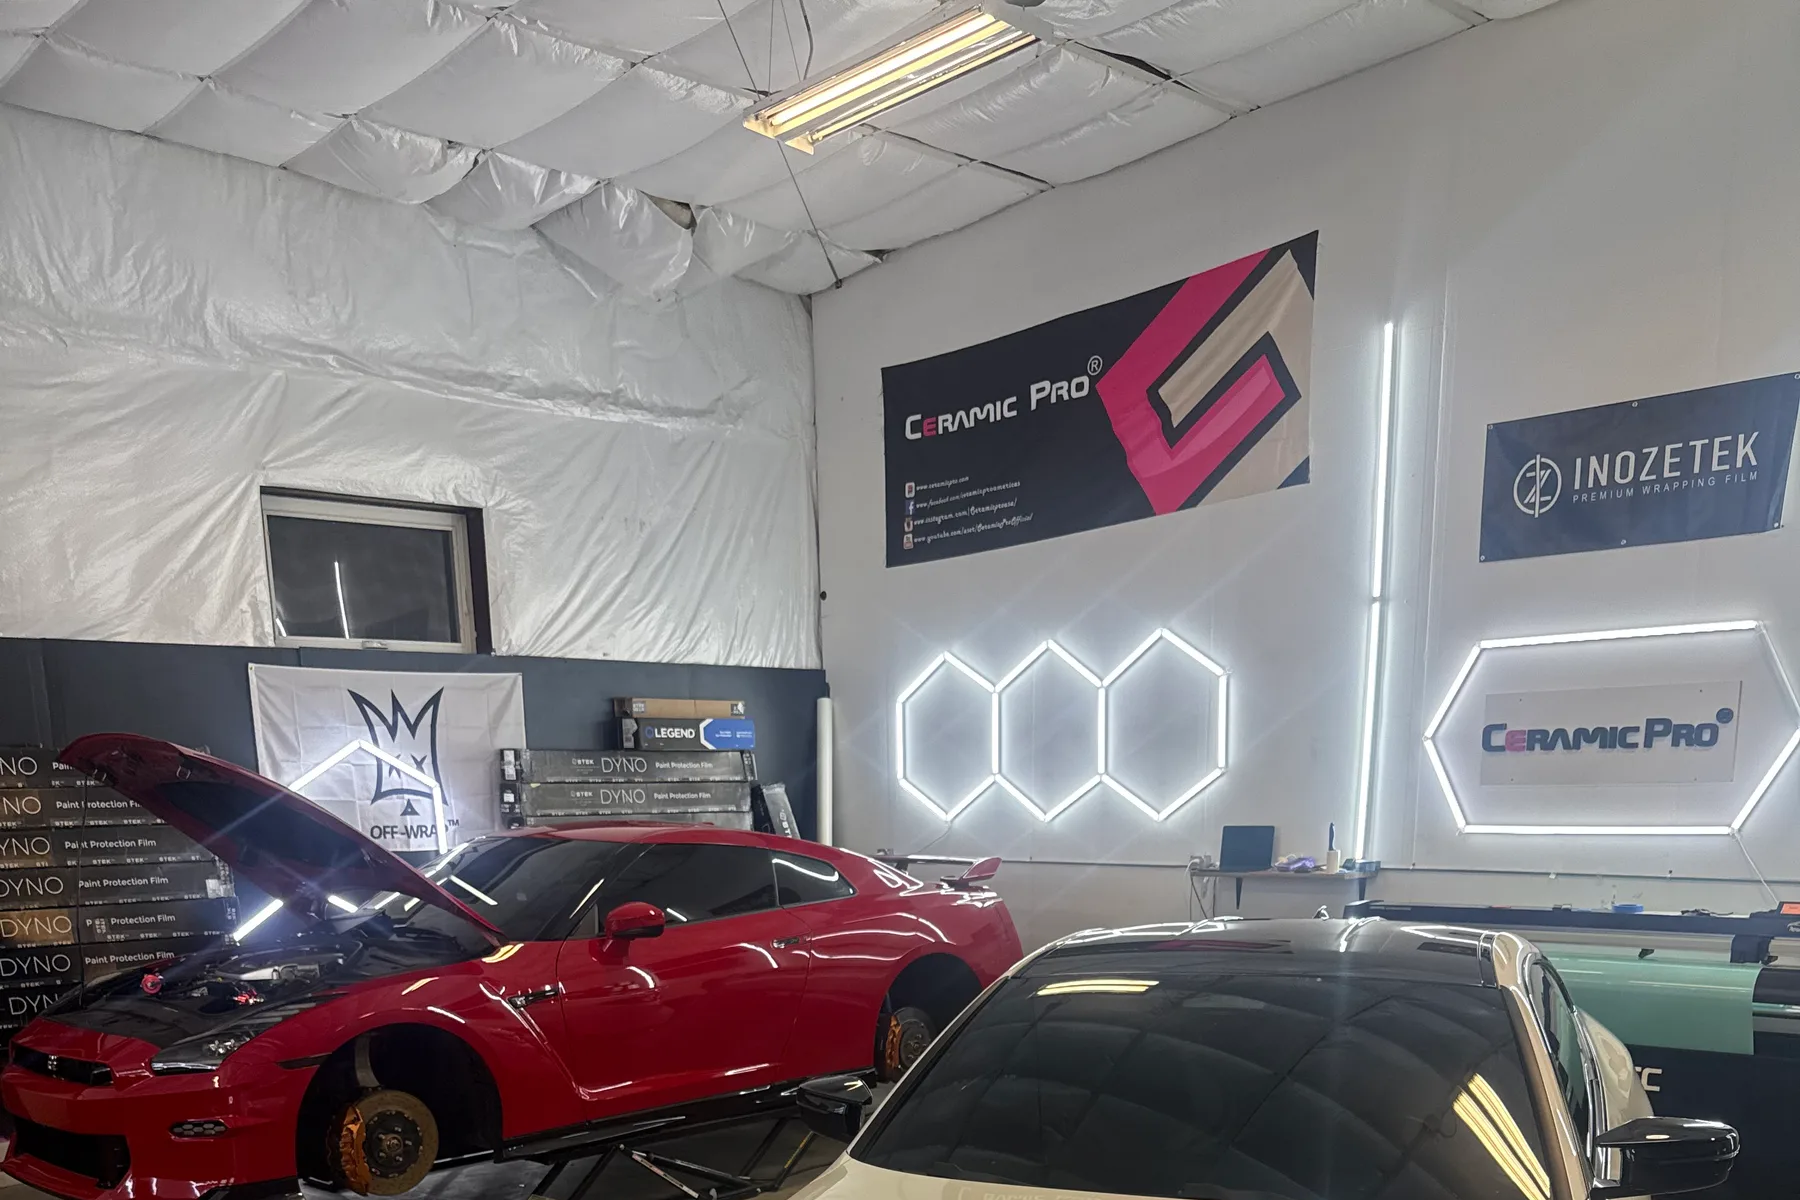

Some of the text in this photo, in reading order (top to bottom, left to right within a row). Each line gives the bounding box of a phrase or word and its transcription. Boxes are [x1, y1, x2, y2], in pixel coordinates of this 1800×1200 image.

[1573, 431, 1760, 490] INOZETEK
[1572, 471, 1758, 504] PREMIUM WRAPPING FILM
[654, 728, 696, 739] LEGEND
[601, 757, 647, 773] DYNO
[655, 761, 670, 769] Paint
[671, 761, 700, 769] Protection
[600, 789, 646, 804] DYNO
[56, 801, 79, 809] Paint
[90, 840, 136, 849] Protection
[138, 839, 156, 847] Film
[79, 879, 101, 889] Paint
[103, 877, 148, 887] Protection
[150, 876, 169, 884] Film
[0, 914, 176, 938] DYNO Protection Film
[0, 951, 175, 977] DYNO Paint Protection Film
